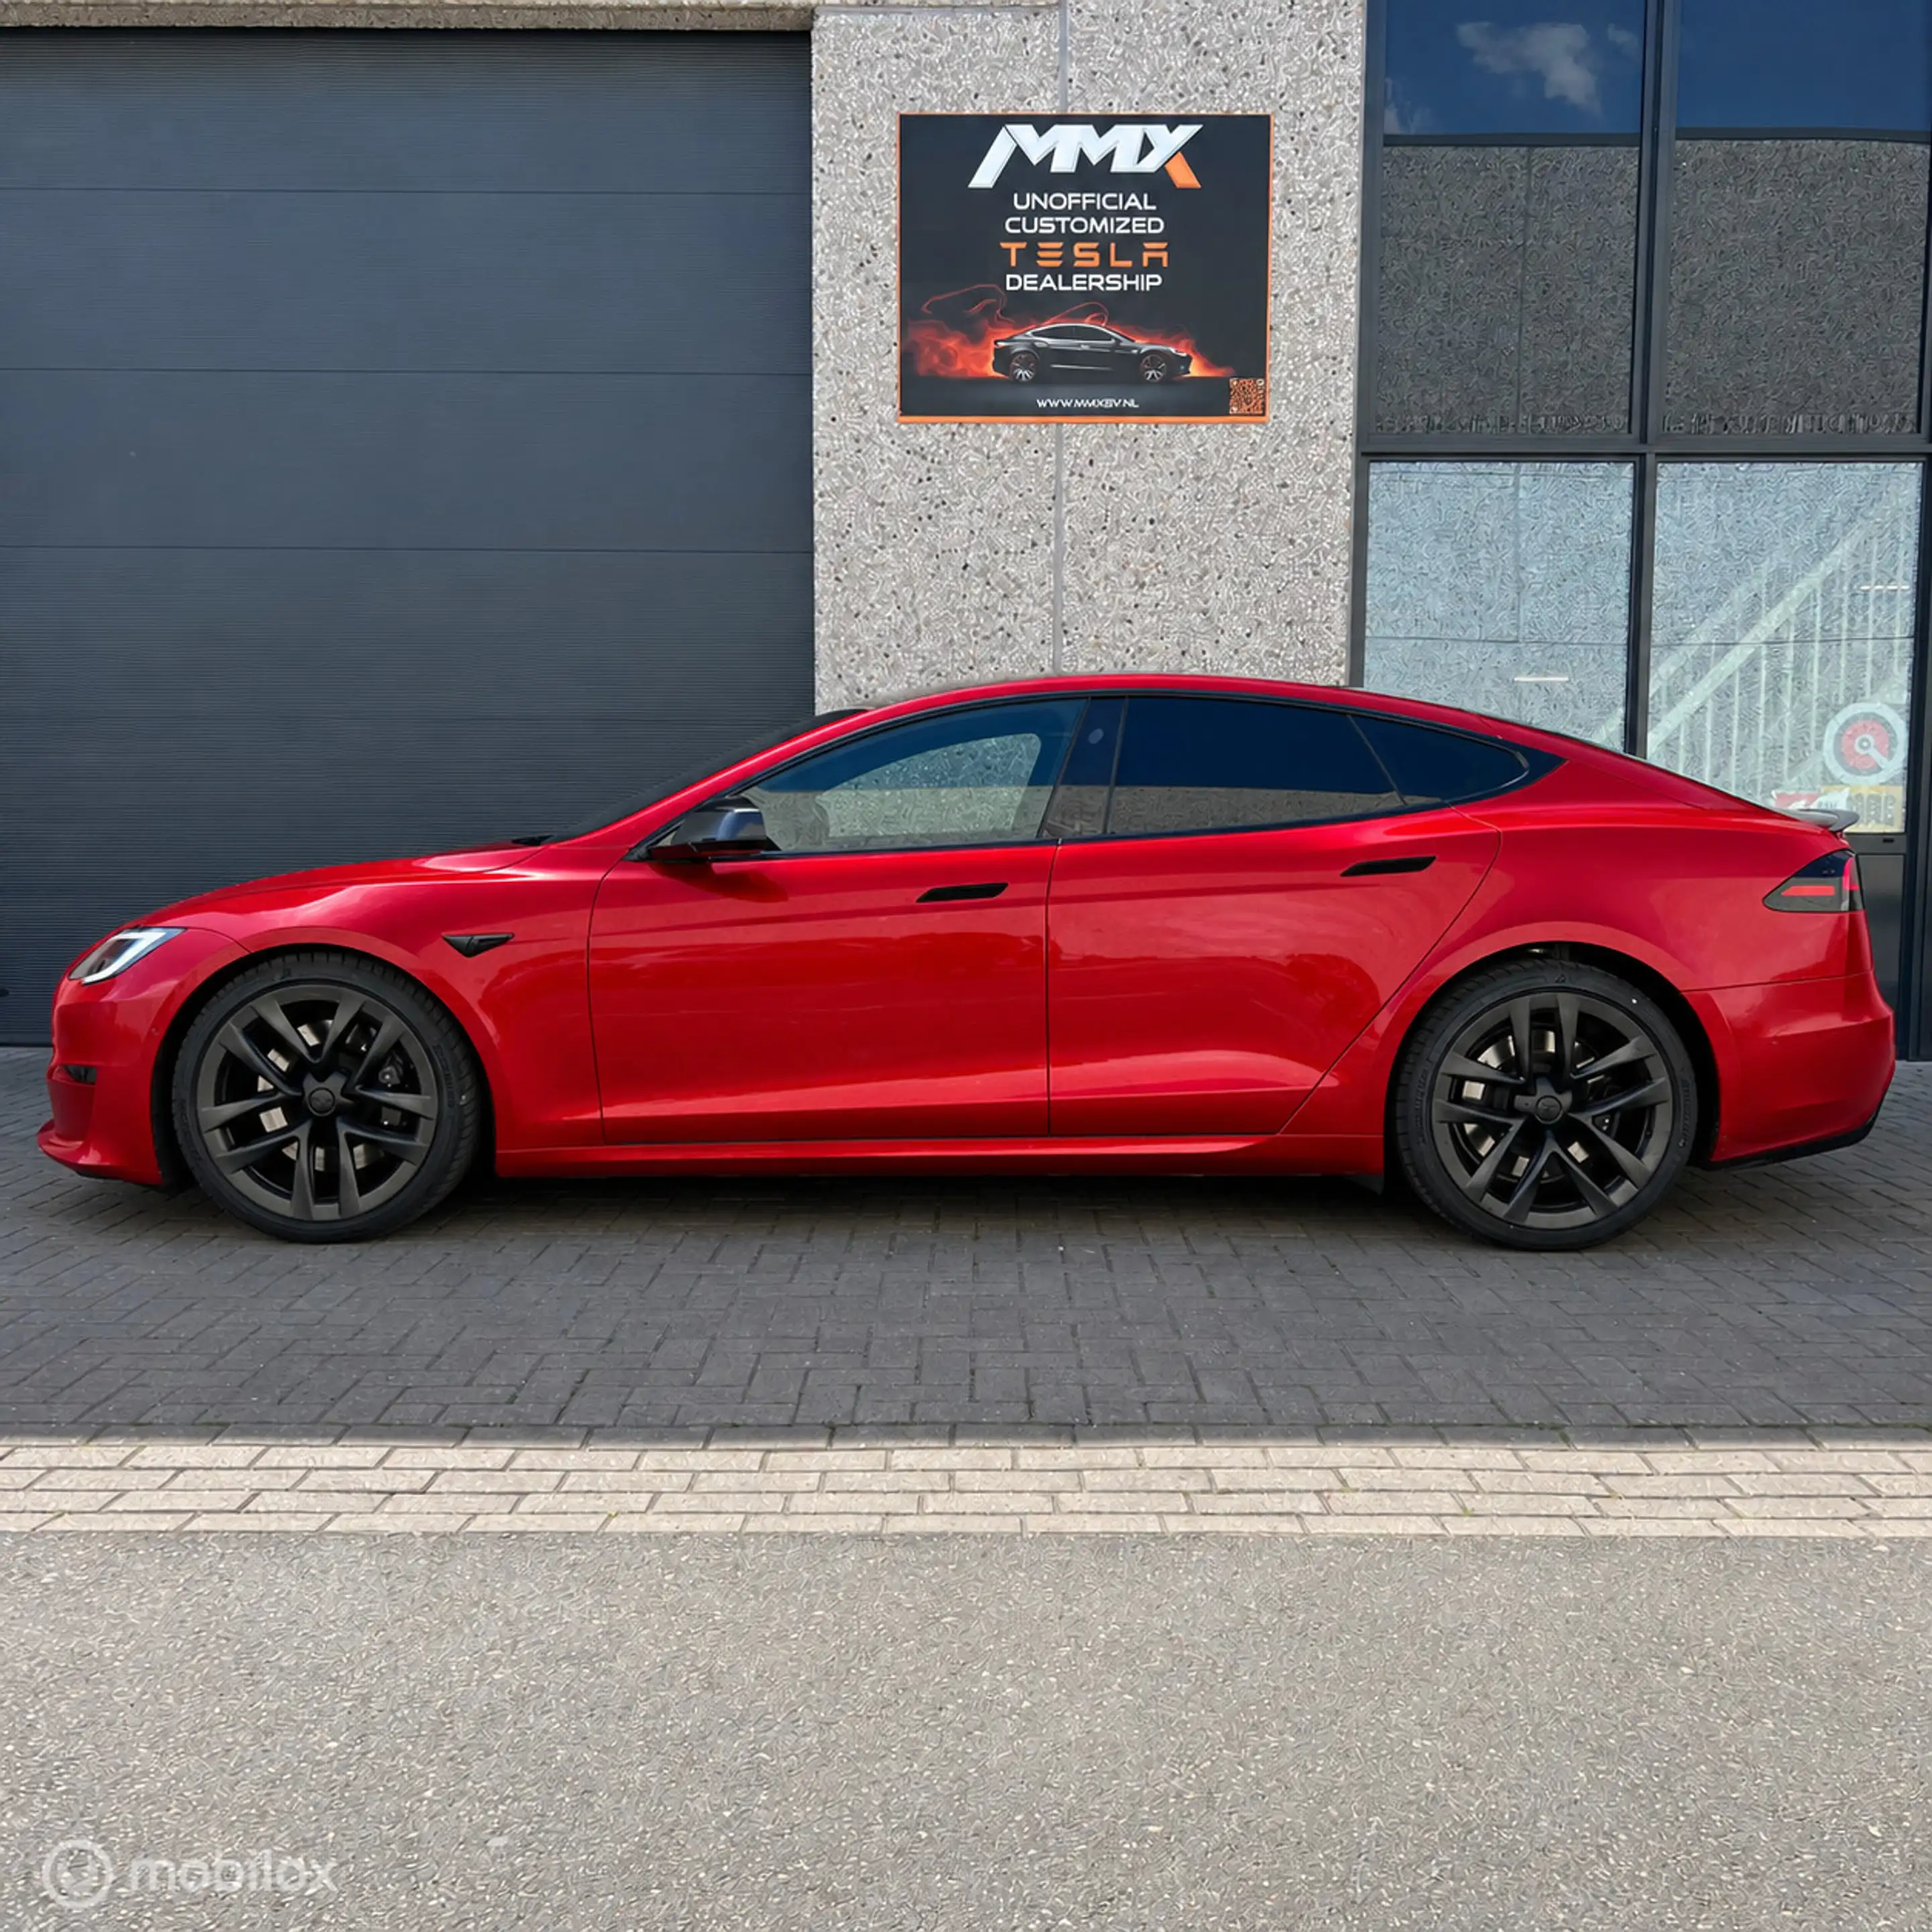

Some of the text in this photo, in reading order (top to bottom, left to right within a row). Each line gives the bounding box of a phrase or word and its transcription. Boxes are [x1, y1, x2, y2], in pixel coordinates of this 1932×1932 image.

[967, 123, 1203, 189] MMX
[1013, 193, 1157, 211] UNOFFICIAL
[1004, 217, 1165, 234] CUSTOMIZED
[1000, 242, 1169, 268] TESLA
[1006, 274, 1163, 291] DEALERSHIP
